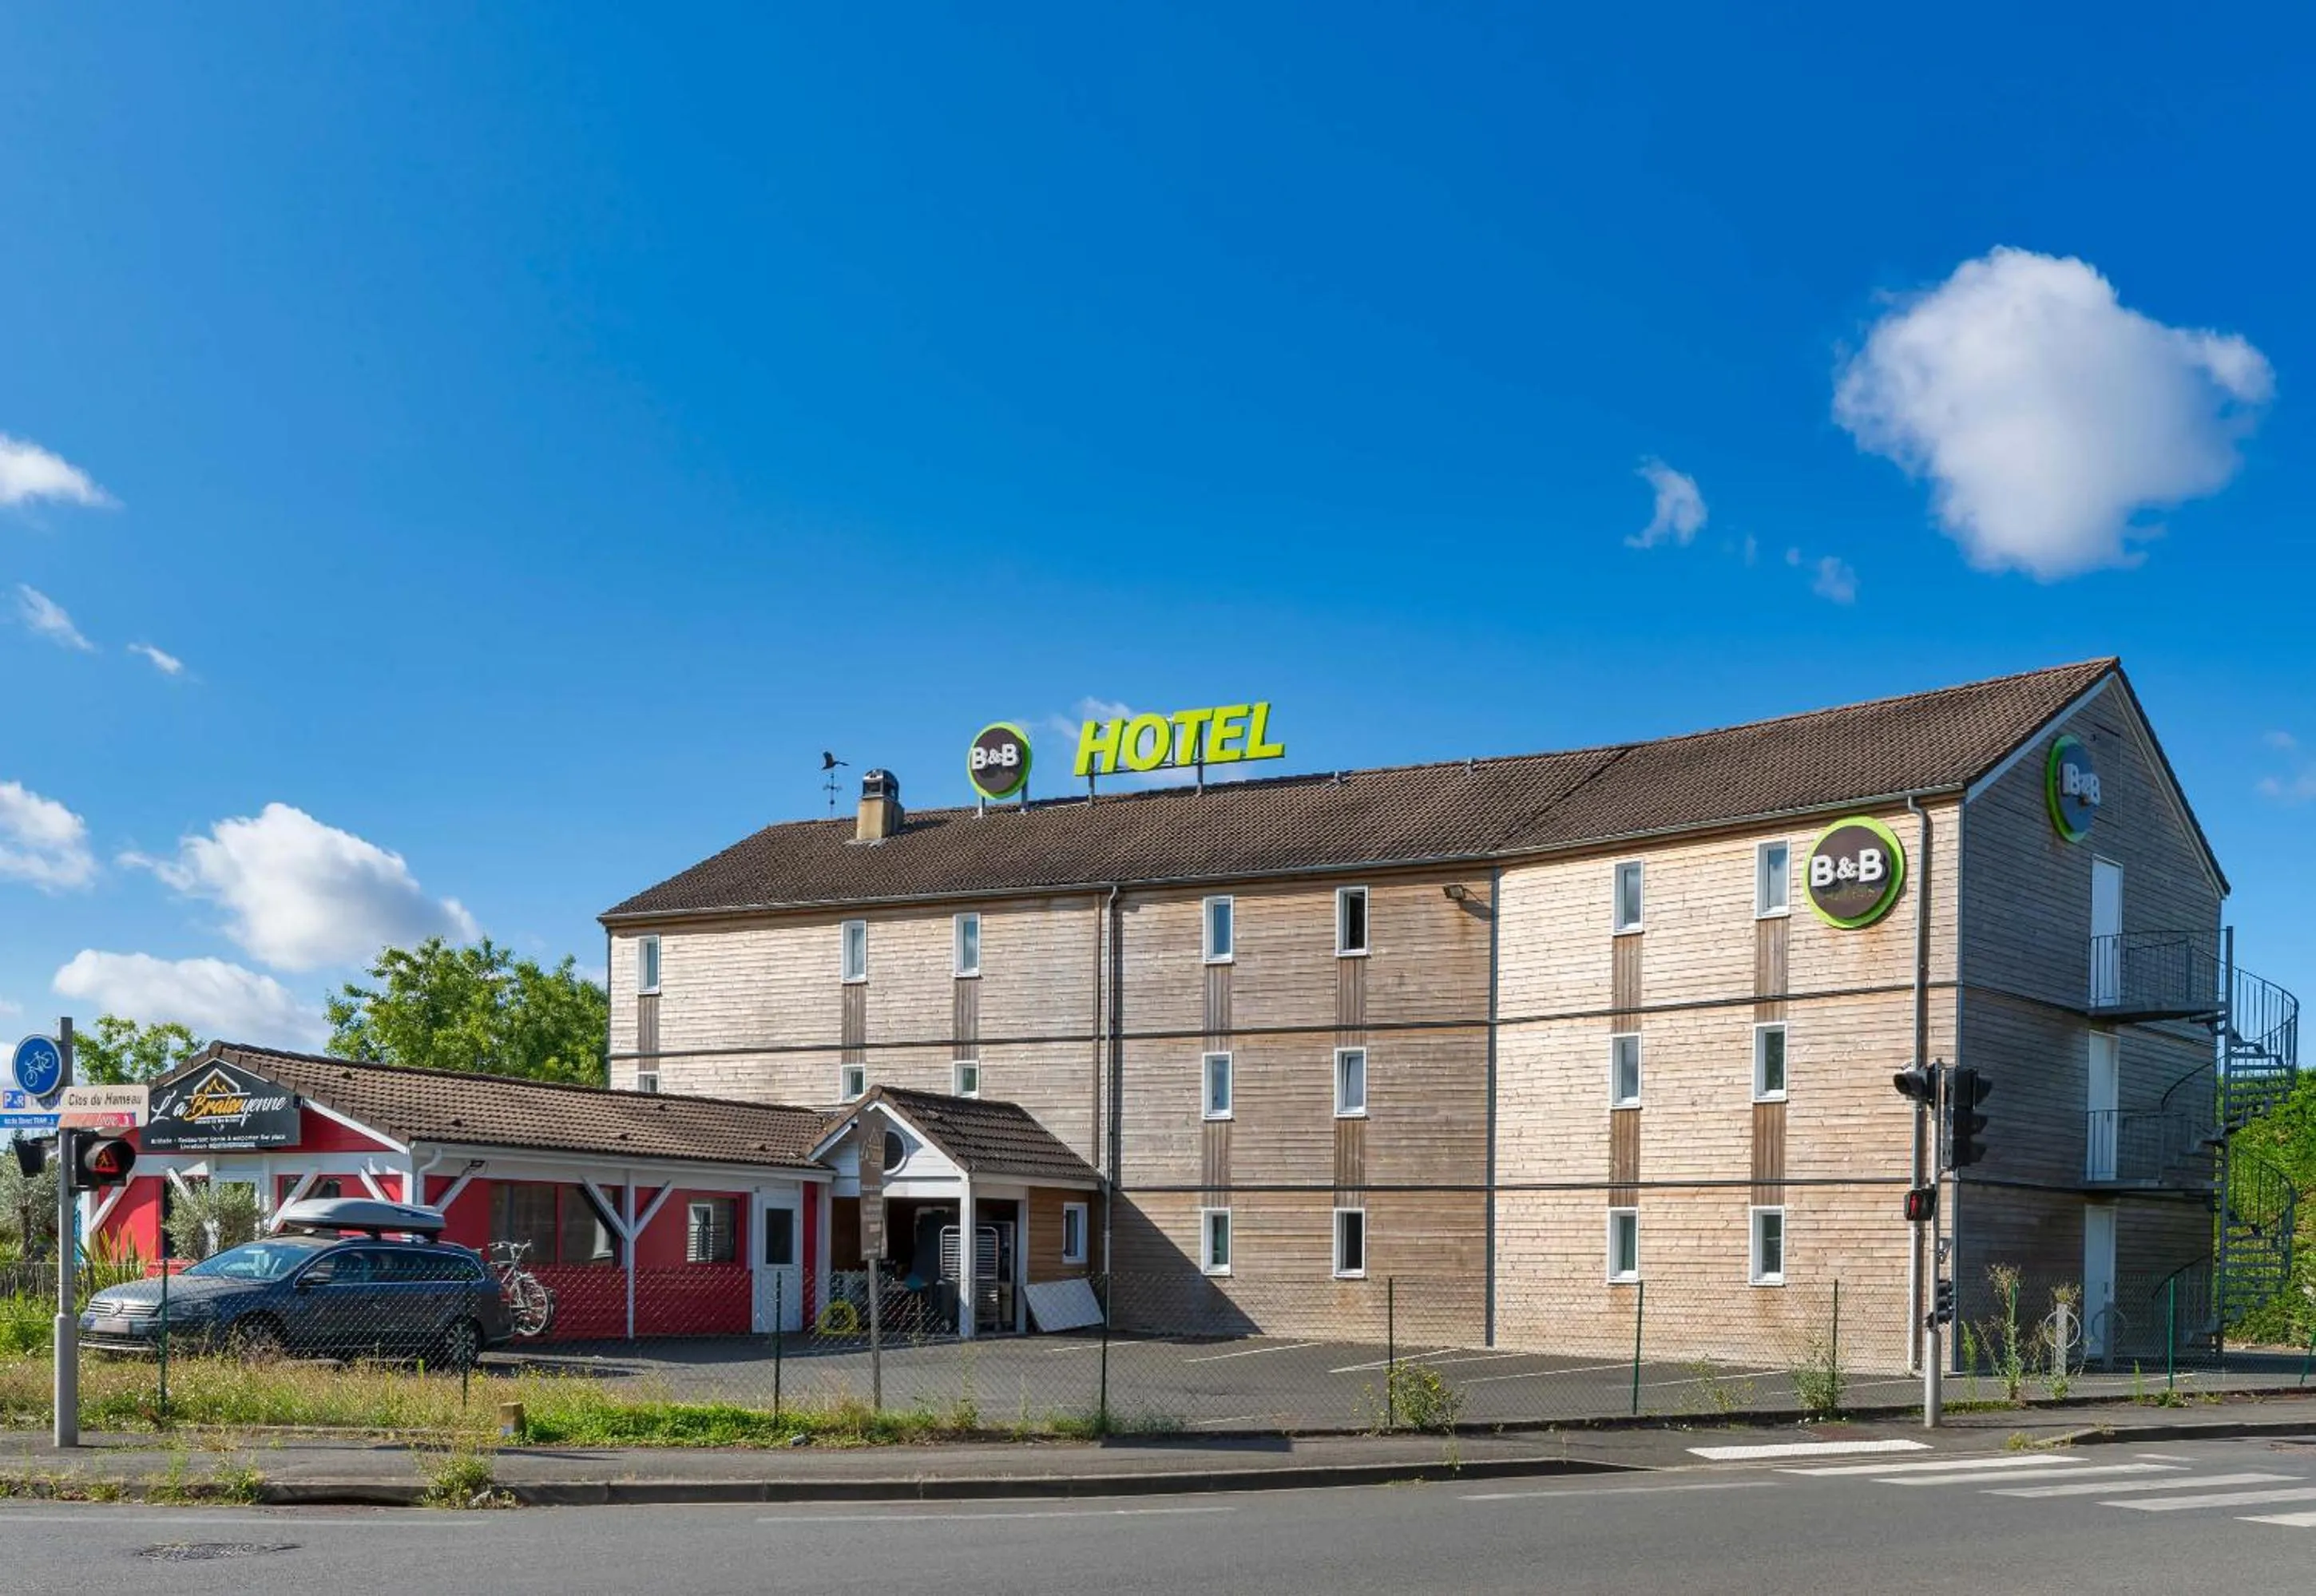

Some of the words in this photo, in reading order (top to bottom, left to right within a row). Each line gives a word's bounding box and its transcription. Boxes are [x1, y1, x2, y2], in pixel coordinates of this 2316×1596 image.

[970, 739, 1019, 770] B&B
[1074, 702, 1285, 776] HOTEL
[1810, 848, 1882, 887] B&B
[68, 1094, 88, 1107] Clos
[90, 1094, 102, 1106] du
[105, 1092, 142, 1105] Hameau
